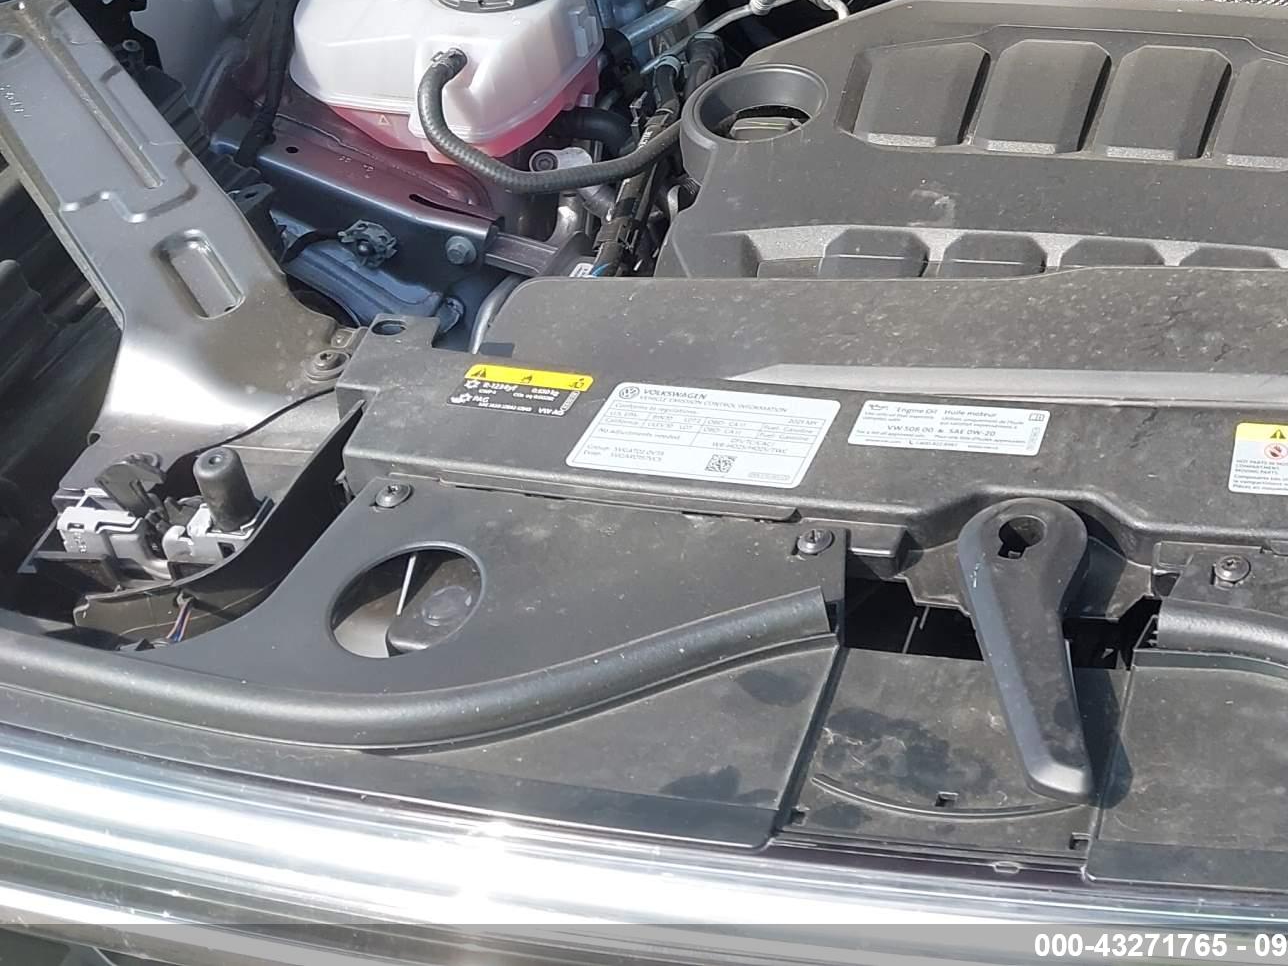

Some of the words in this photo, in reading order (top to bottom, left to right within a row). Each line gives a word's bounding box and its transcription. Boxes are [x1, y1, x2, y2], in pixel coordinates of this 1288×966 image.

[643, 388, 708, 400] VOLKSWAGEN
[703, 400, 736, 409] CONTROL
[737, 402, 788, 413] INFORMATION
[896, 406, 925, 415] Engine
